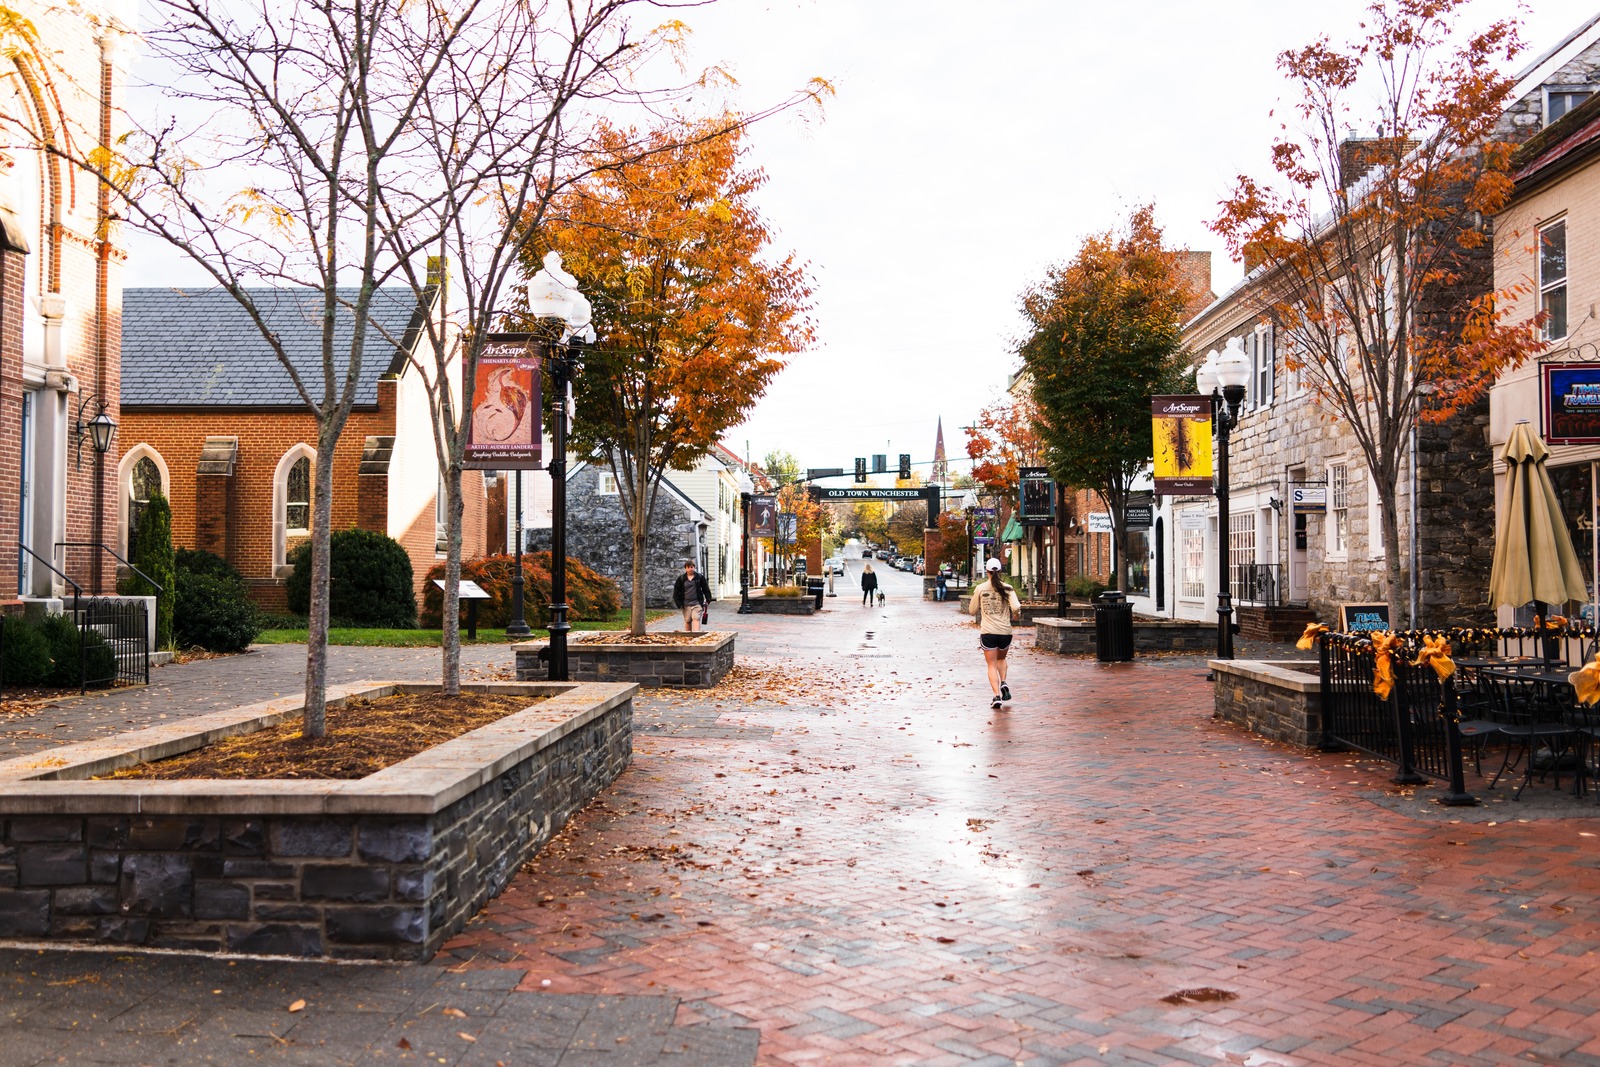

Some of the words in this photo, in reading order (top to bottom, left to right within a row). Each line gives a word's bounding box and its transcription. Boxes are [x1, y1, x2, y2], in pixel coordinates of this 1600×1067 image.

[1572, 384, 1600, 395] TIME
[1564, 394, 1600, 406] TRAVEL
[1163, 403, 1200, 413] ArtScape
[1295, 490, 1303, 501] S
[1354, 613, 1382, 622] TIME
